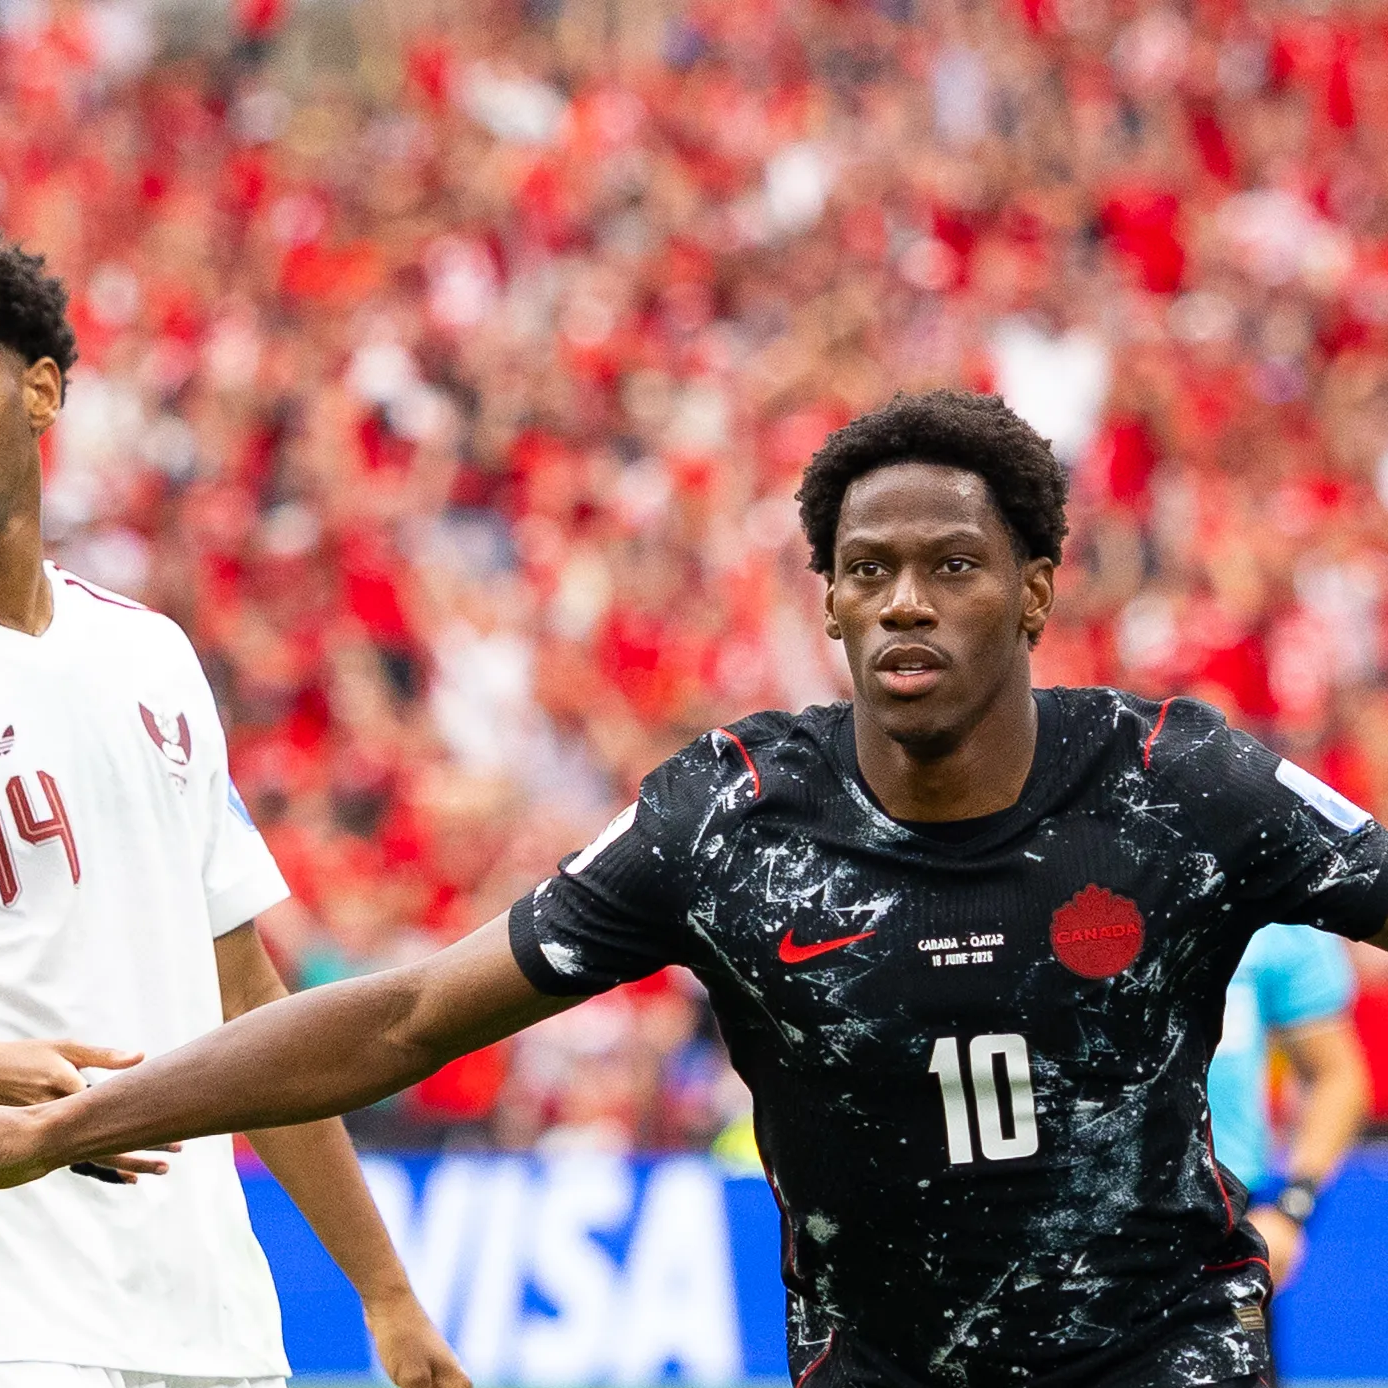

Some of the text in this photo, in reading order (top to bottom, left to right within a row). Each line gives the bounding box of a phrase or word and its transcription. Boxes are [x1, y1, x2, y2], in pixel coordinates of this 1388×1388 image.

[918, 938, 958, 951] CANADA
[969, 934, 1004, 948] QATAR
[1056, 923, 1140, 944] CANADA
[932, 951, 993, 967] 18 JUNE 2026
[929, 1033, 1039, 1165] 10
